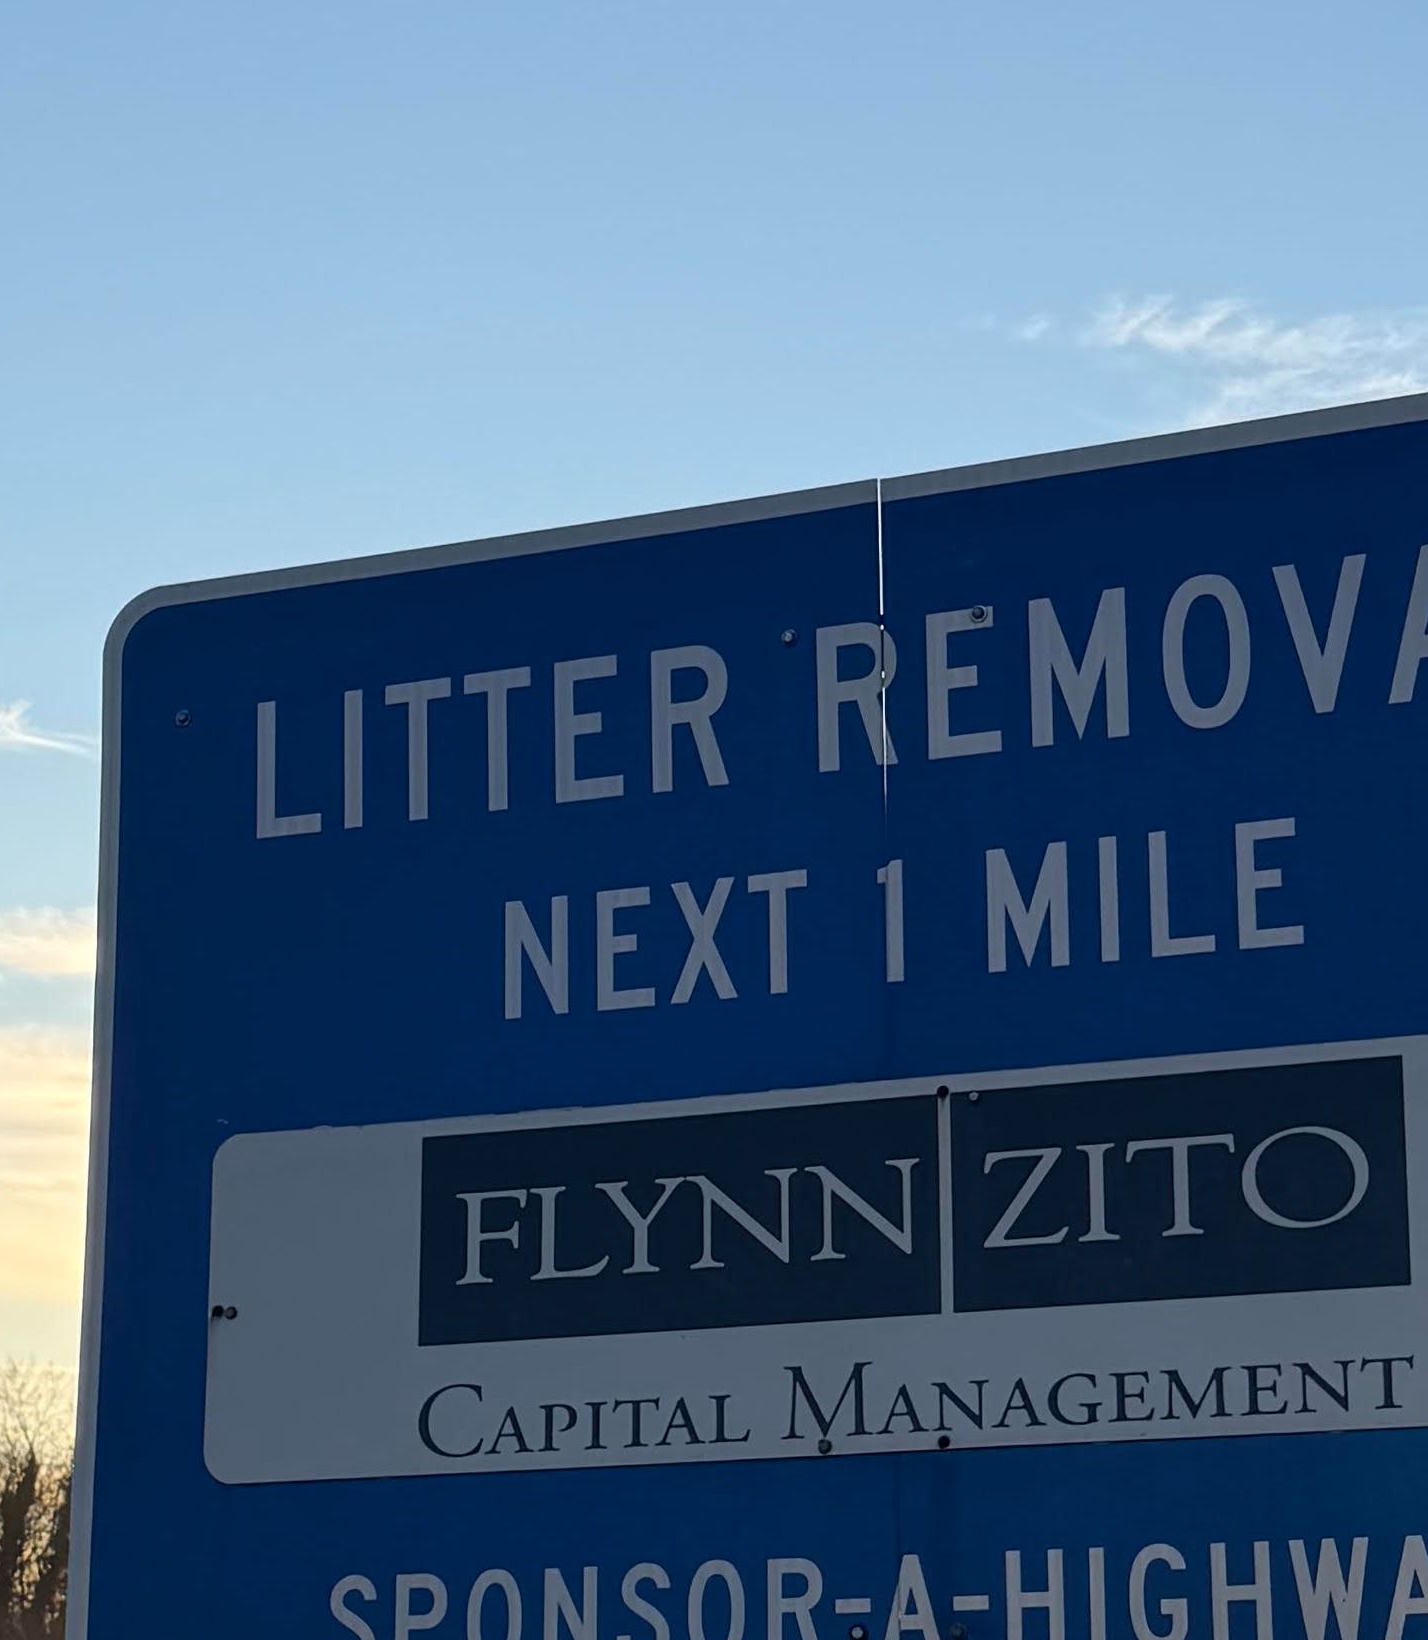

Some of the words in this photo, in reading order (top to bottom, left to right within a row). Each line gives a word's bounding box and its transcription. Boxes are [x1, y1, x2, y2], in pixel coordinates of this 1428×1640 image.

[256, 644, 730, 840] LITTER
[503, 869, 808, 1019] NEXT
[878, 859, 906, 982] 1
[986, 817, 1305, 974] MILE
[454, 1157, 922, 1287] FLYNN
[982, 1124, 1371, 1251] ZITO
